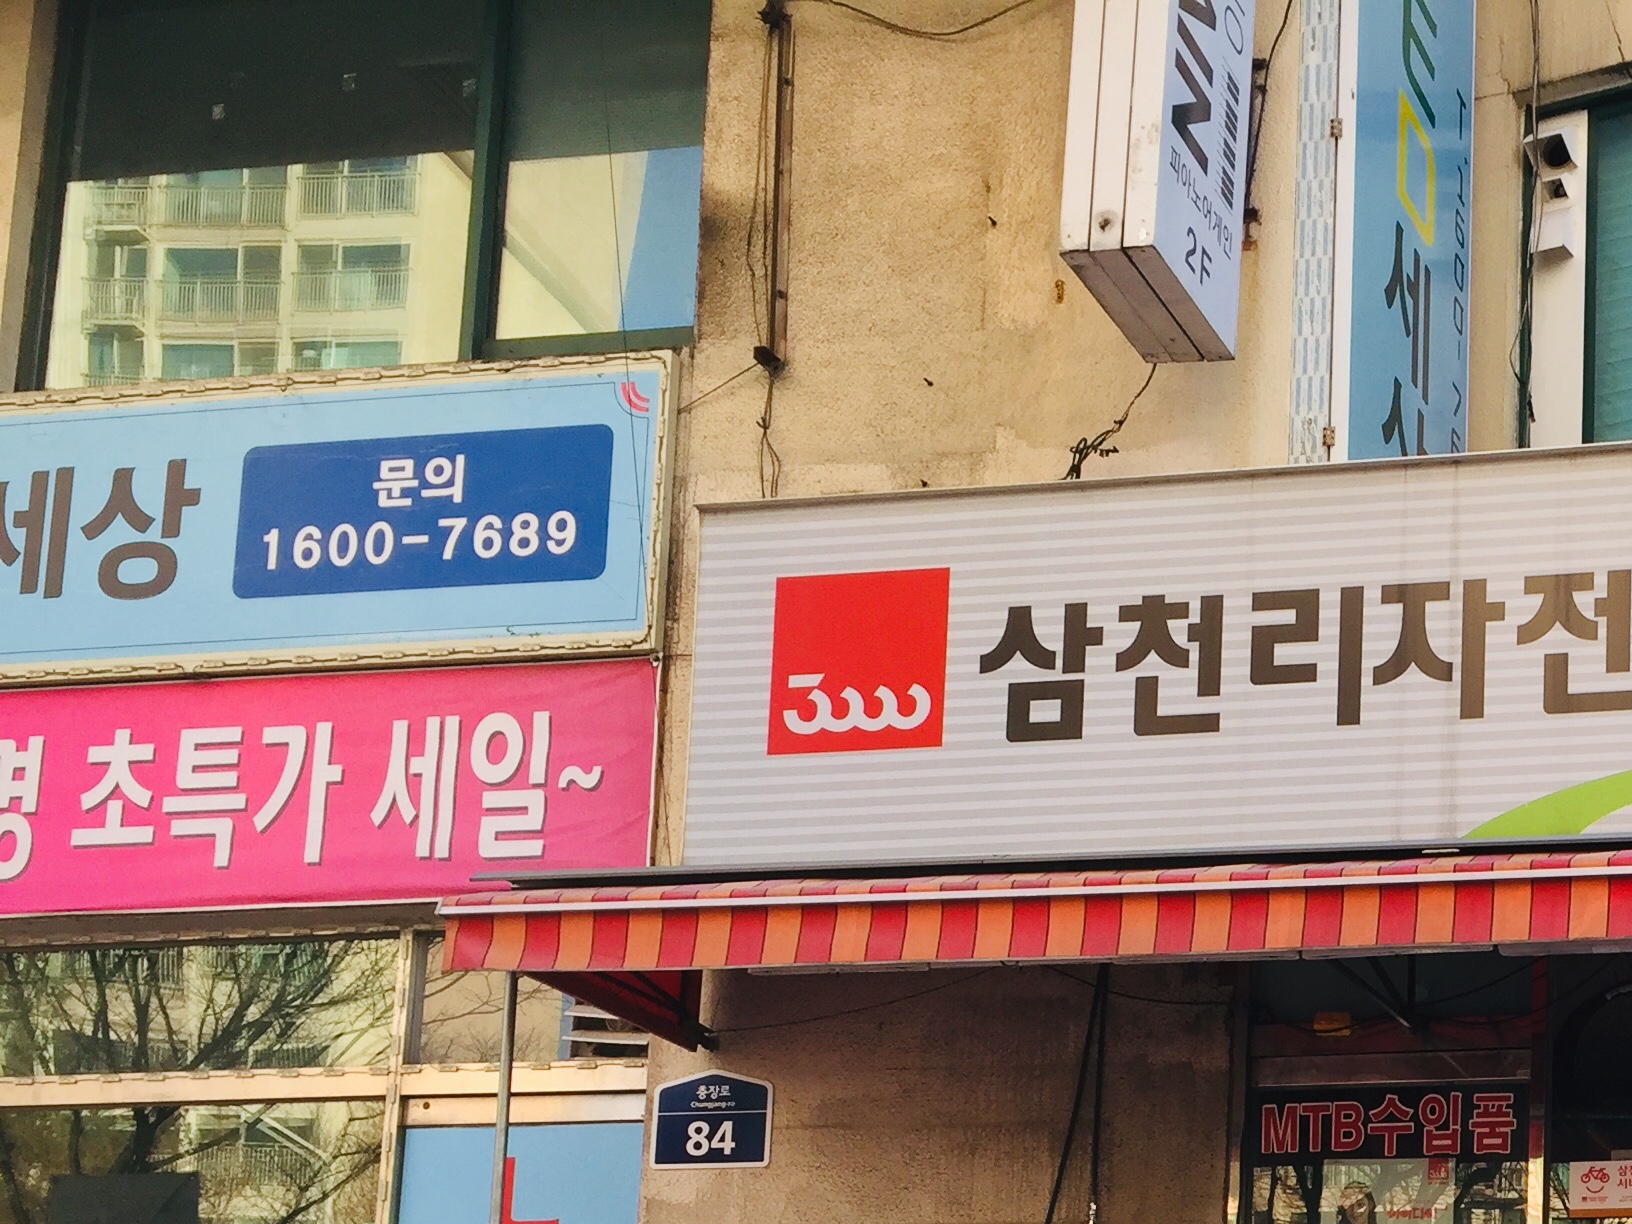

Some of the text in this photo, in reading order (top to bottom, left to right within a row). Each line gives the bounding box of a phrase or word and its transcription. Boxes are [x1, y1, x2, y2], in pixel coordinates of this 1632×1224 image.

[1184, 226, 1213, 286] 2F
[371, 453, 467, 508] 문의
[262, 509, 578, 571] 1600-7689
[70, 721, 342, 870] 초특가
[685, 1120, 736, 1157] 84
